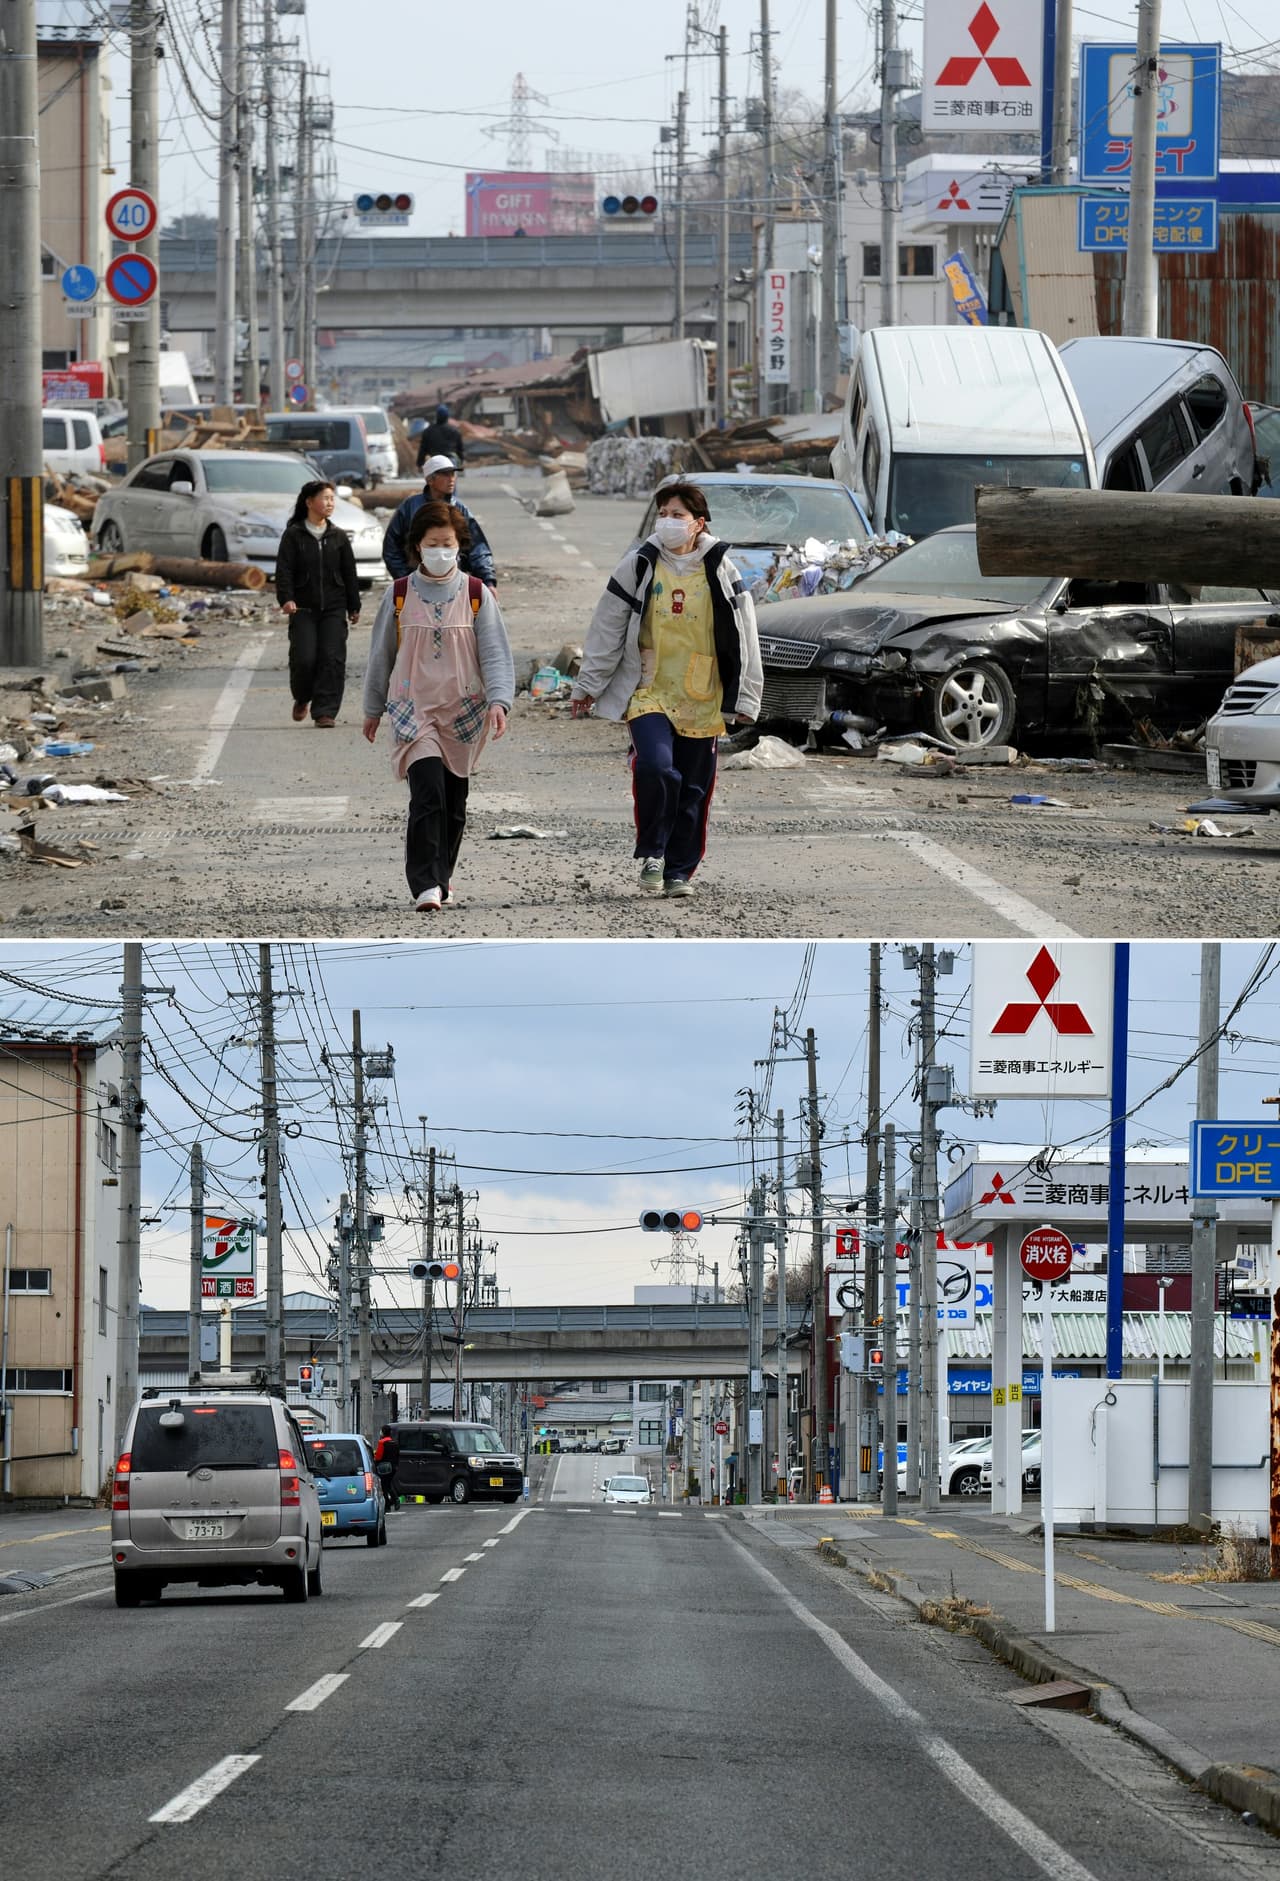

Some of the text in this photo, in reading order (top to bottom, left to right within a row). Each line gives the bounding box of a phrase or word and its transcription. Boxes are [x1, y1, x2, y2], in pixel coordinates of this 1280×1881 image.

[933, 100, 1033, 117] 三菱商事石油
[496, 194, 532, 209] GIFT
[117, 204, 146, 227] 40
[1095, 206, 1204, 222] クリニング
[770, 275, 785, 370] ロータス今野
[978, 1060, 1105, 1074] 三菱商事エネルギー
[1216, 1162, 1272, 1184] DPE
[1025, 1244, 1067, 1264] 消火栓
[202, 1281, 215, 1294] TM
[219, 1281, 232, 1294] 酒
[236, 1281, 254, 1294] たばこ
[952, 1380, 993, 1392] タイヤシ
[1011, 1384, 1019, 1400] 出口
[996, 1389, 1003, 1404] 入口
[194, 1526, 223, 1537] 73-73
